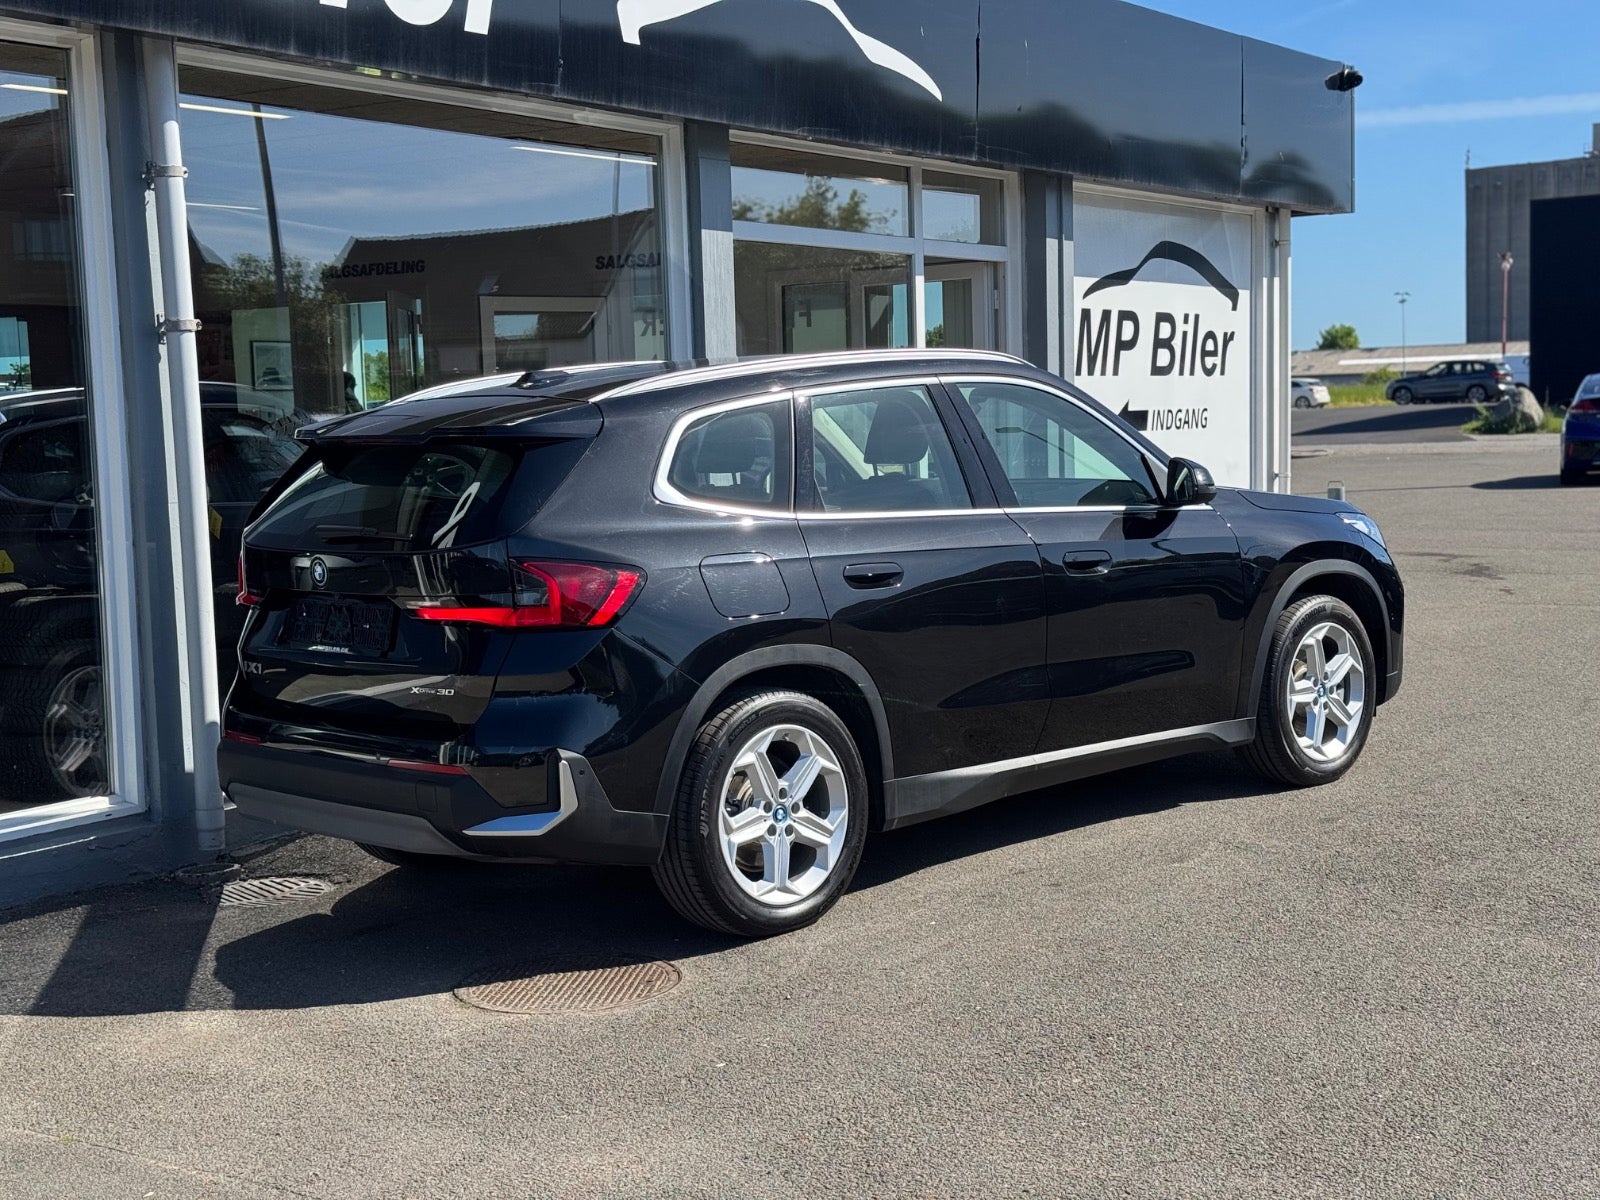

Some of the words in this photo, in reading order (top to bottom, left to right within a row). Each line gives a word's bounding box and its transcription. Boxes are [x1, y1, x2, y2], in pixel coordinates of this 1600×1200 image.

[1075, 308, 1140, 377] MP
[1150, 312, 1236, 377] Biler
[1151, 408, 1208, 431] INDGANG
